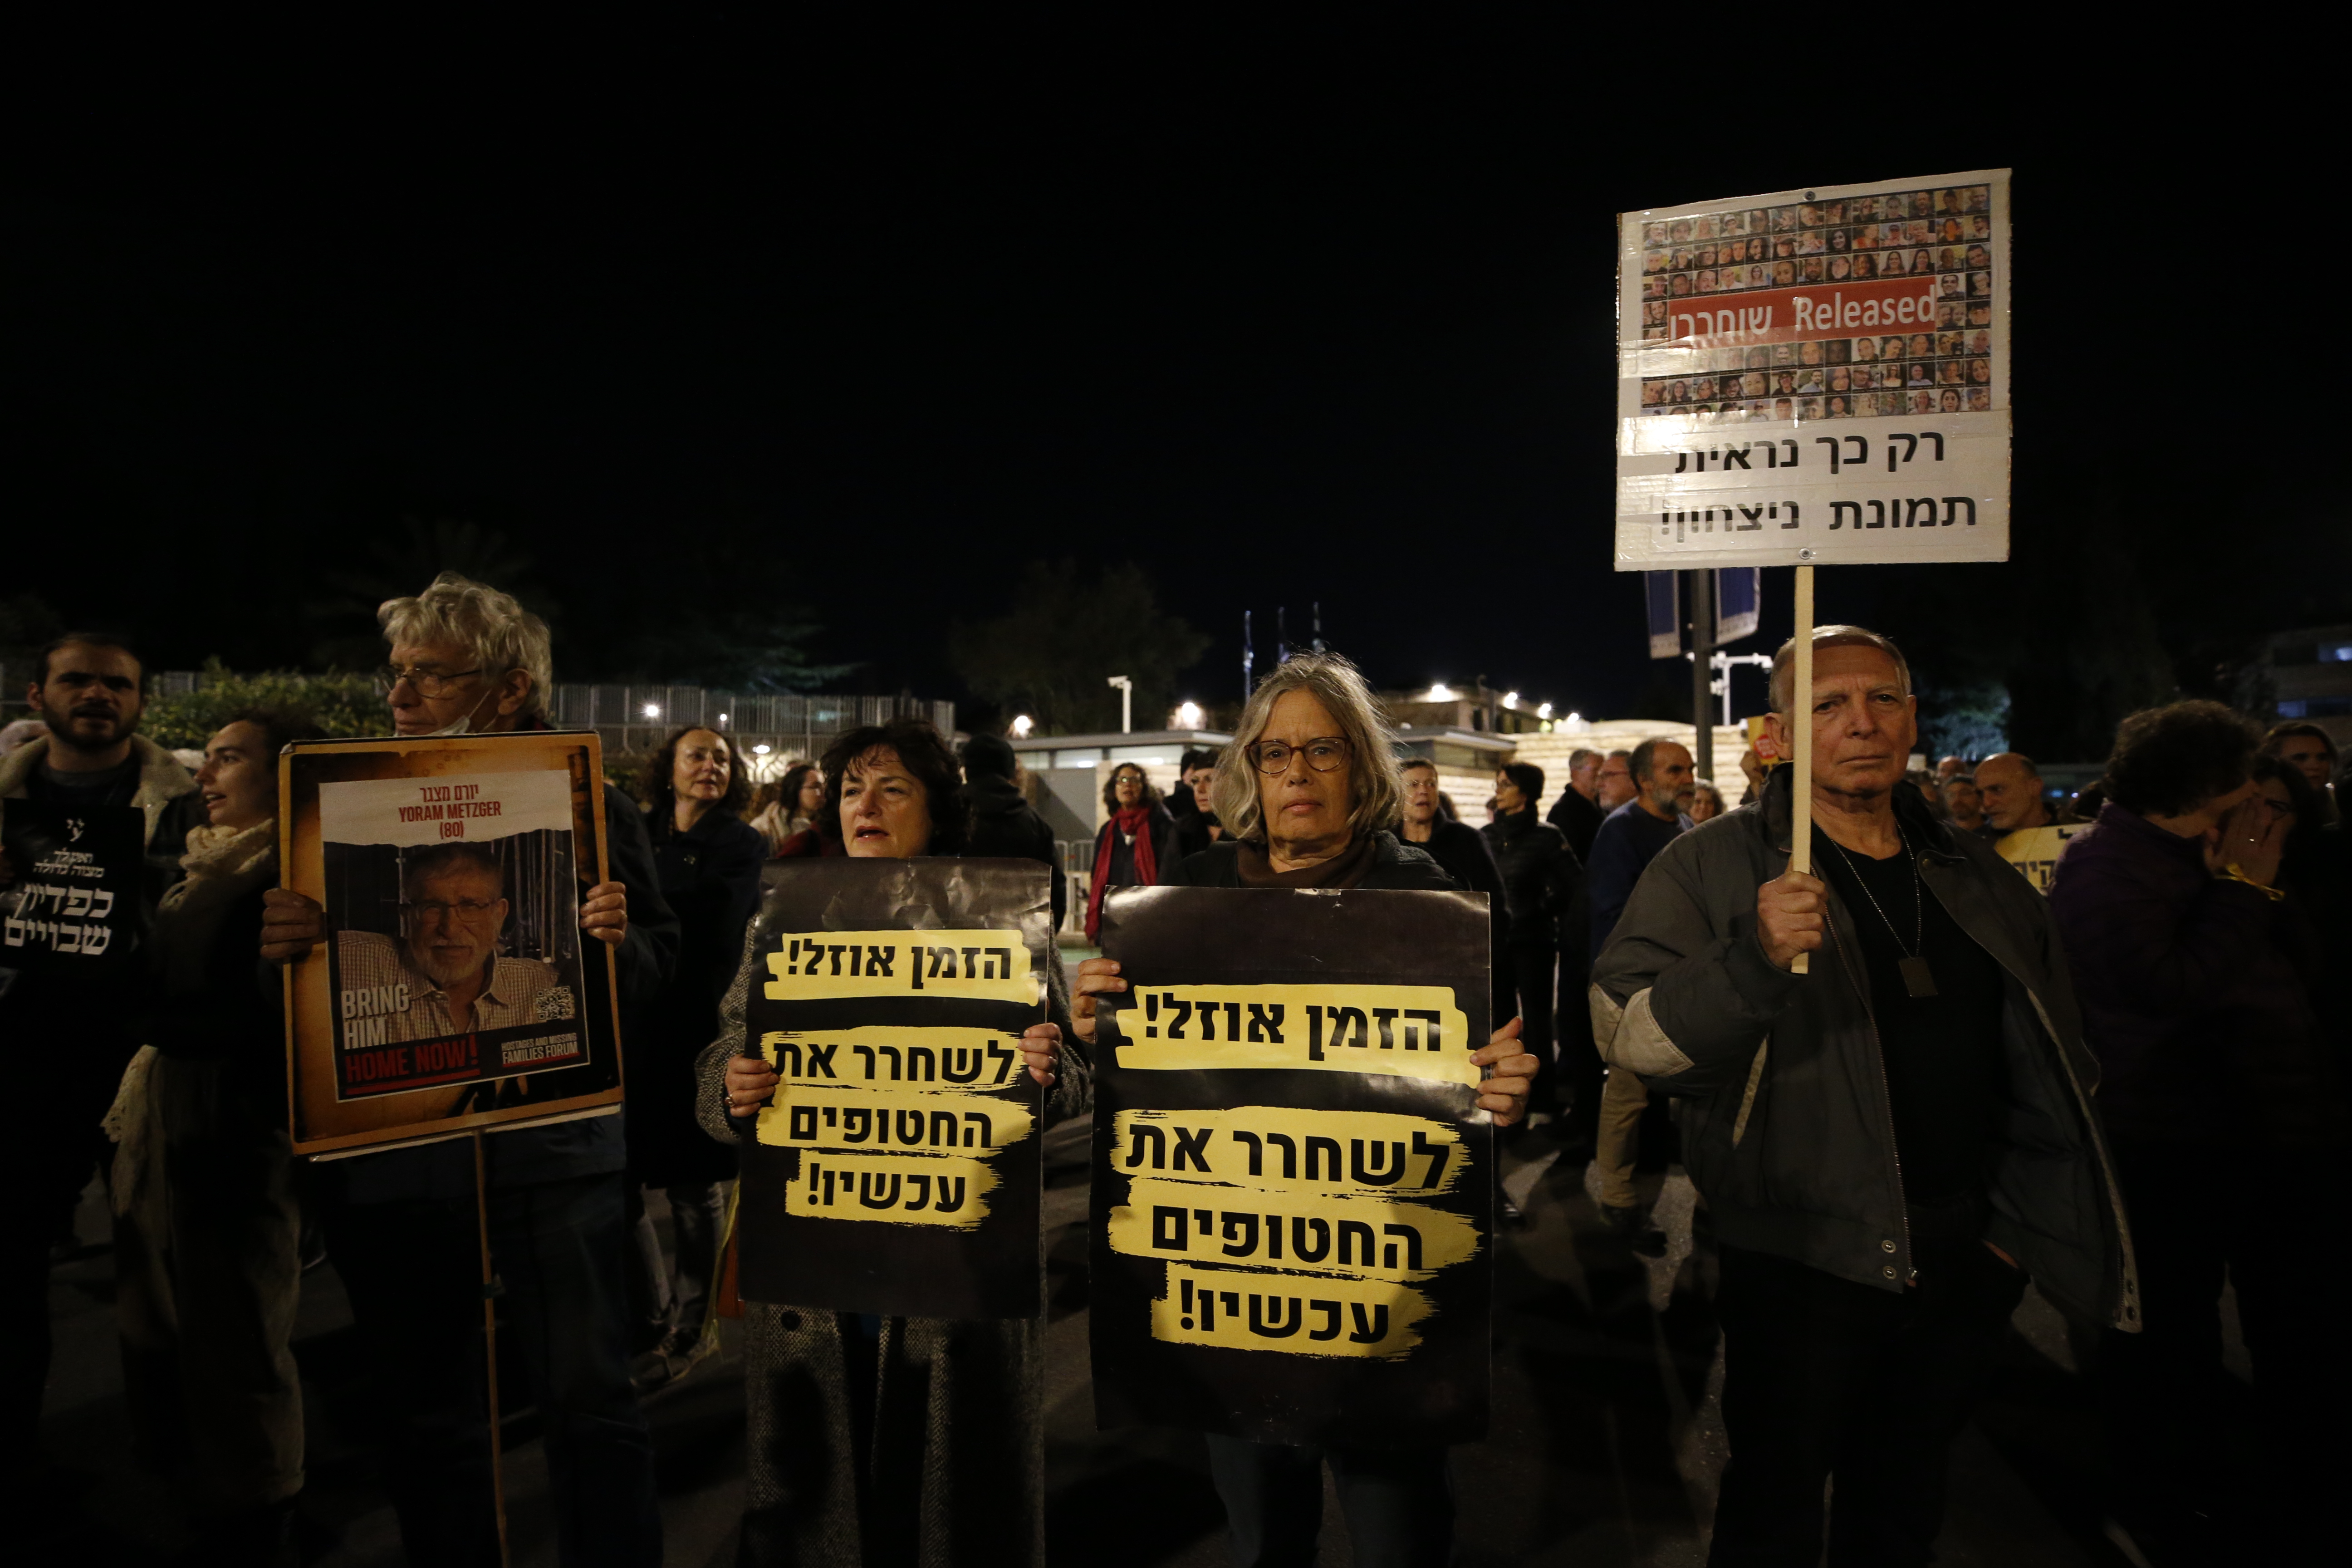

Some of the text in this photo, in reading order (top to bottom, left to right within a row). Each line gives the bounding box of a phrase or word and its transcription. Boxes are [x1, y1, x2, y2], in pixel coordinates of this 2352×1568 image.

[1795, 284, 1935, 331] Released
[1816, 436, 1868, 474] כך
[1888, 432, 1944, 472] רק
[1661, 496, 1976, 543] תמונת ניצחון!
[399, 801, 501, 822] YORAM METZGER
[420, 784, 479, 802] יורם מצגר
[440, 821, 464, 839] (80)
[13, 882, 114, 918] כפדיון
[4, 916, 112, 956] שבויים
[789, 939, 1011, 990] הזמן אוזל!
[341, 984, 409, 1019] BRING
[343, 1016, 387, 1050] HIM
[1146, 993, 1441, 1061] הזמן אוזל!
[345, 1034, 479, 1083] HOME NOW!
[502, 1041, 578, 1064] FAMILIES FORUM
[772, 1040, 1014, 1084] לשחרר את
[790, 1105, 992, 1148] החטופים
[1126, 1124, 1450, 1189] לשחרר את
[808, 1163, 965, 1212] עכשיו!
[1152, 1205, 1422, 1269] החטופים
[1181, 1280, 1388, 1344] עכשיו!
